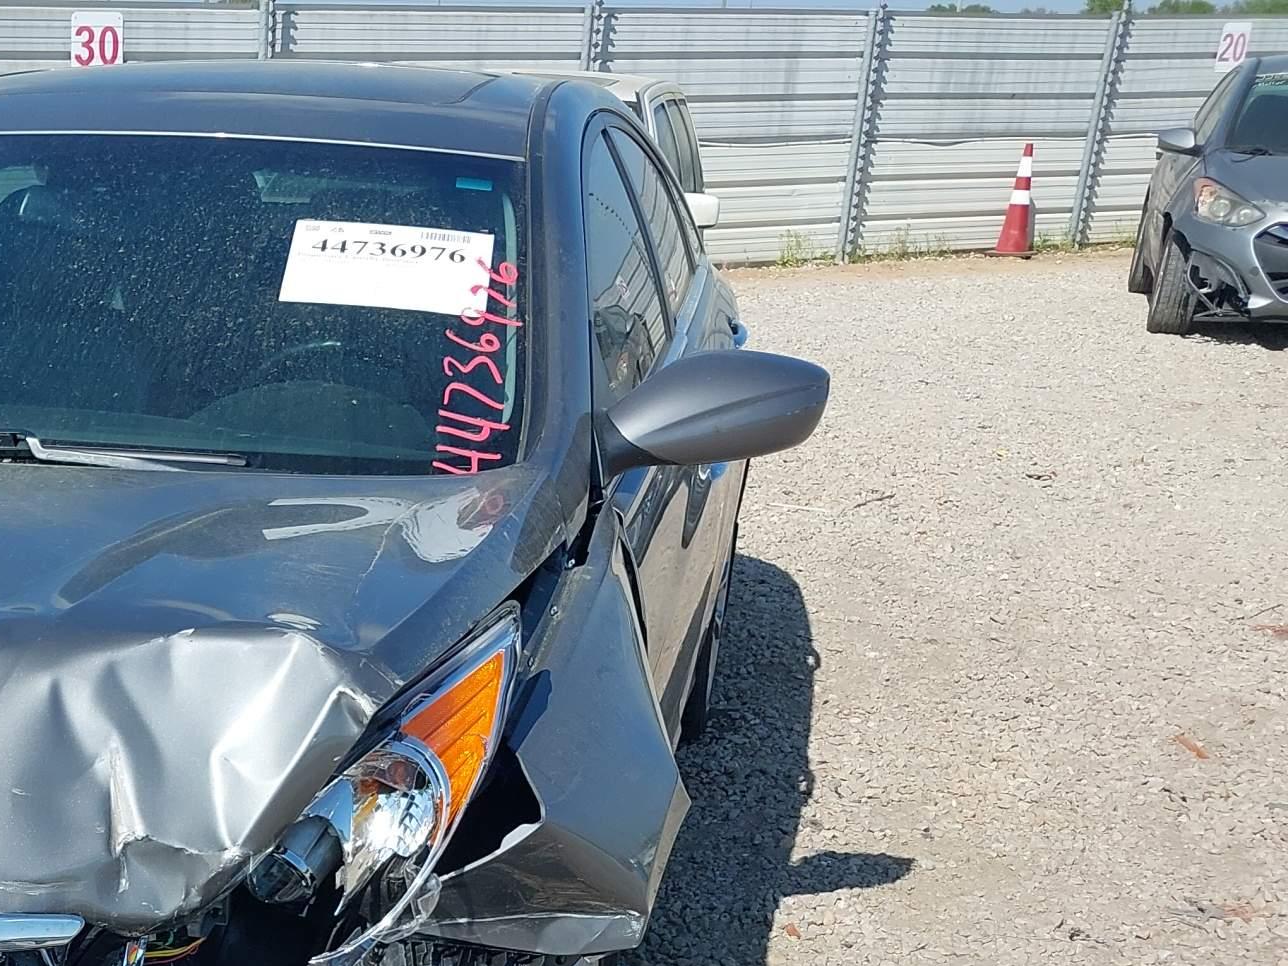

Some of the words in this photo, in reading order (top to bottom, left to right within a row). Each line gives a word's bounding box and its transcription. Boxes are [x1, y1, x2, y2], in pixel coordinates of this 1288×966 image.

[75, 26, 119, 67] 30
[1217, 33, 1246, 62] 20
[312, 237, 466, 264] 44736976
[432, 256, 524, 475] 44736976
